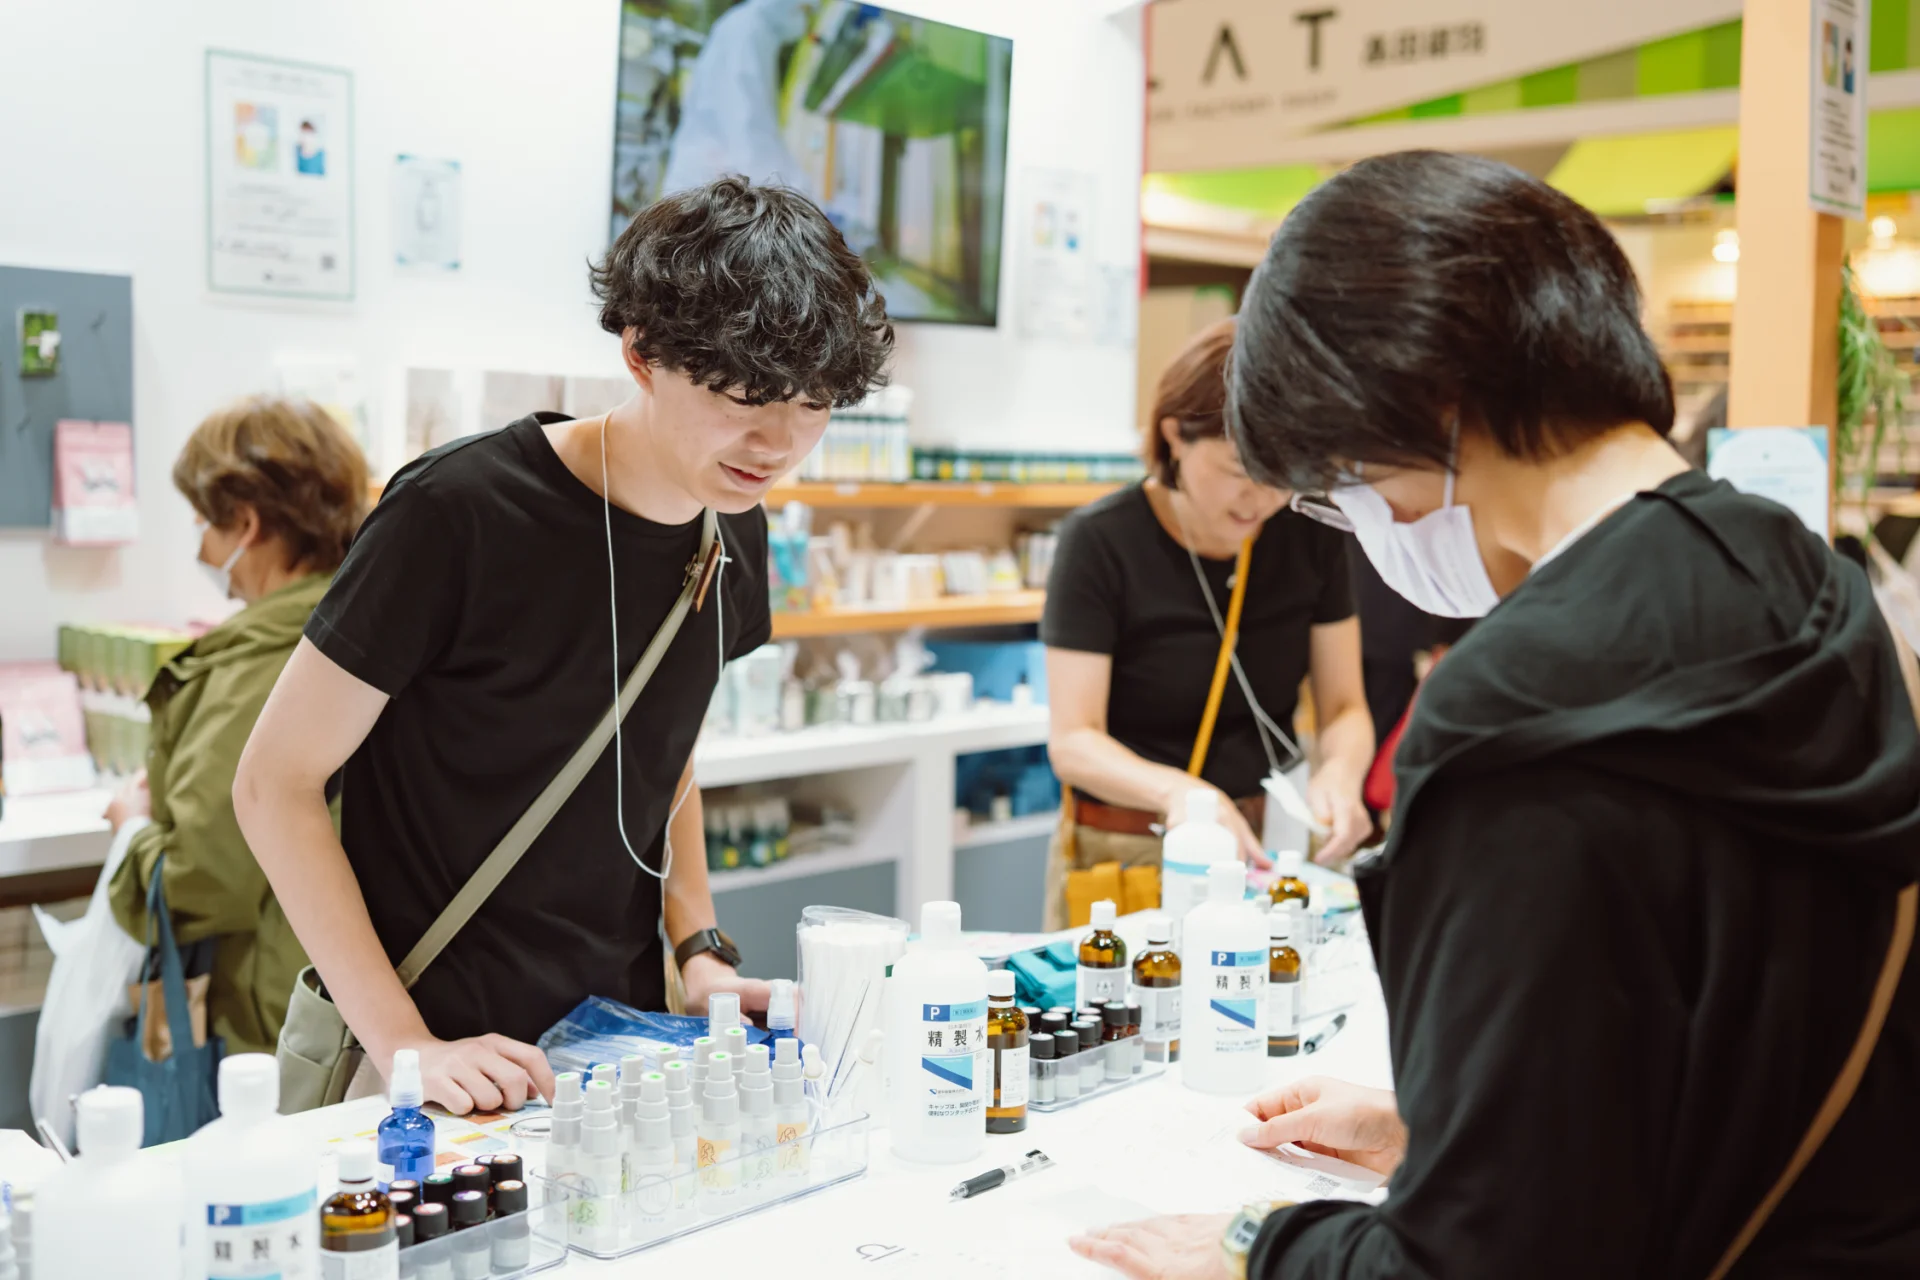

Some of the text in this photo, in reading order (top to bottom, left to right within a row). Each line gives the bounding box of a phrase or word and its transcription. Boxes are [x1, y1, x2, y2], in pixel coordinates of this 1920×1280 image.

[1218, 952, 1227, 965] P
[930, 1006, 941, 1021] P
[928, 1025, 984, 1047] 精製水
[214, 1205, 230, 1225] P
